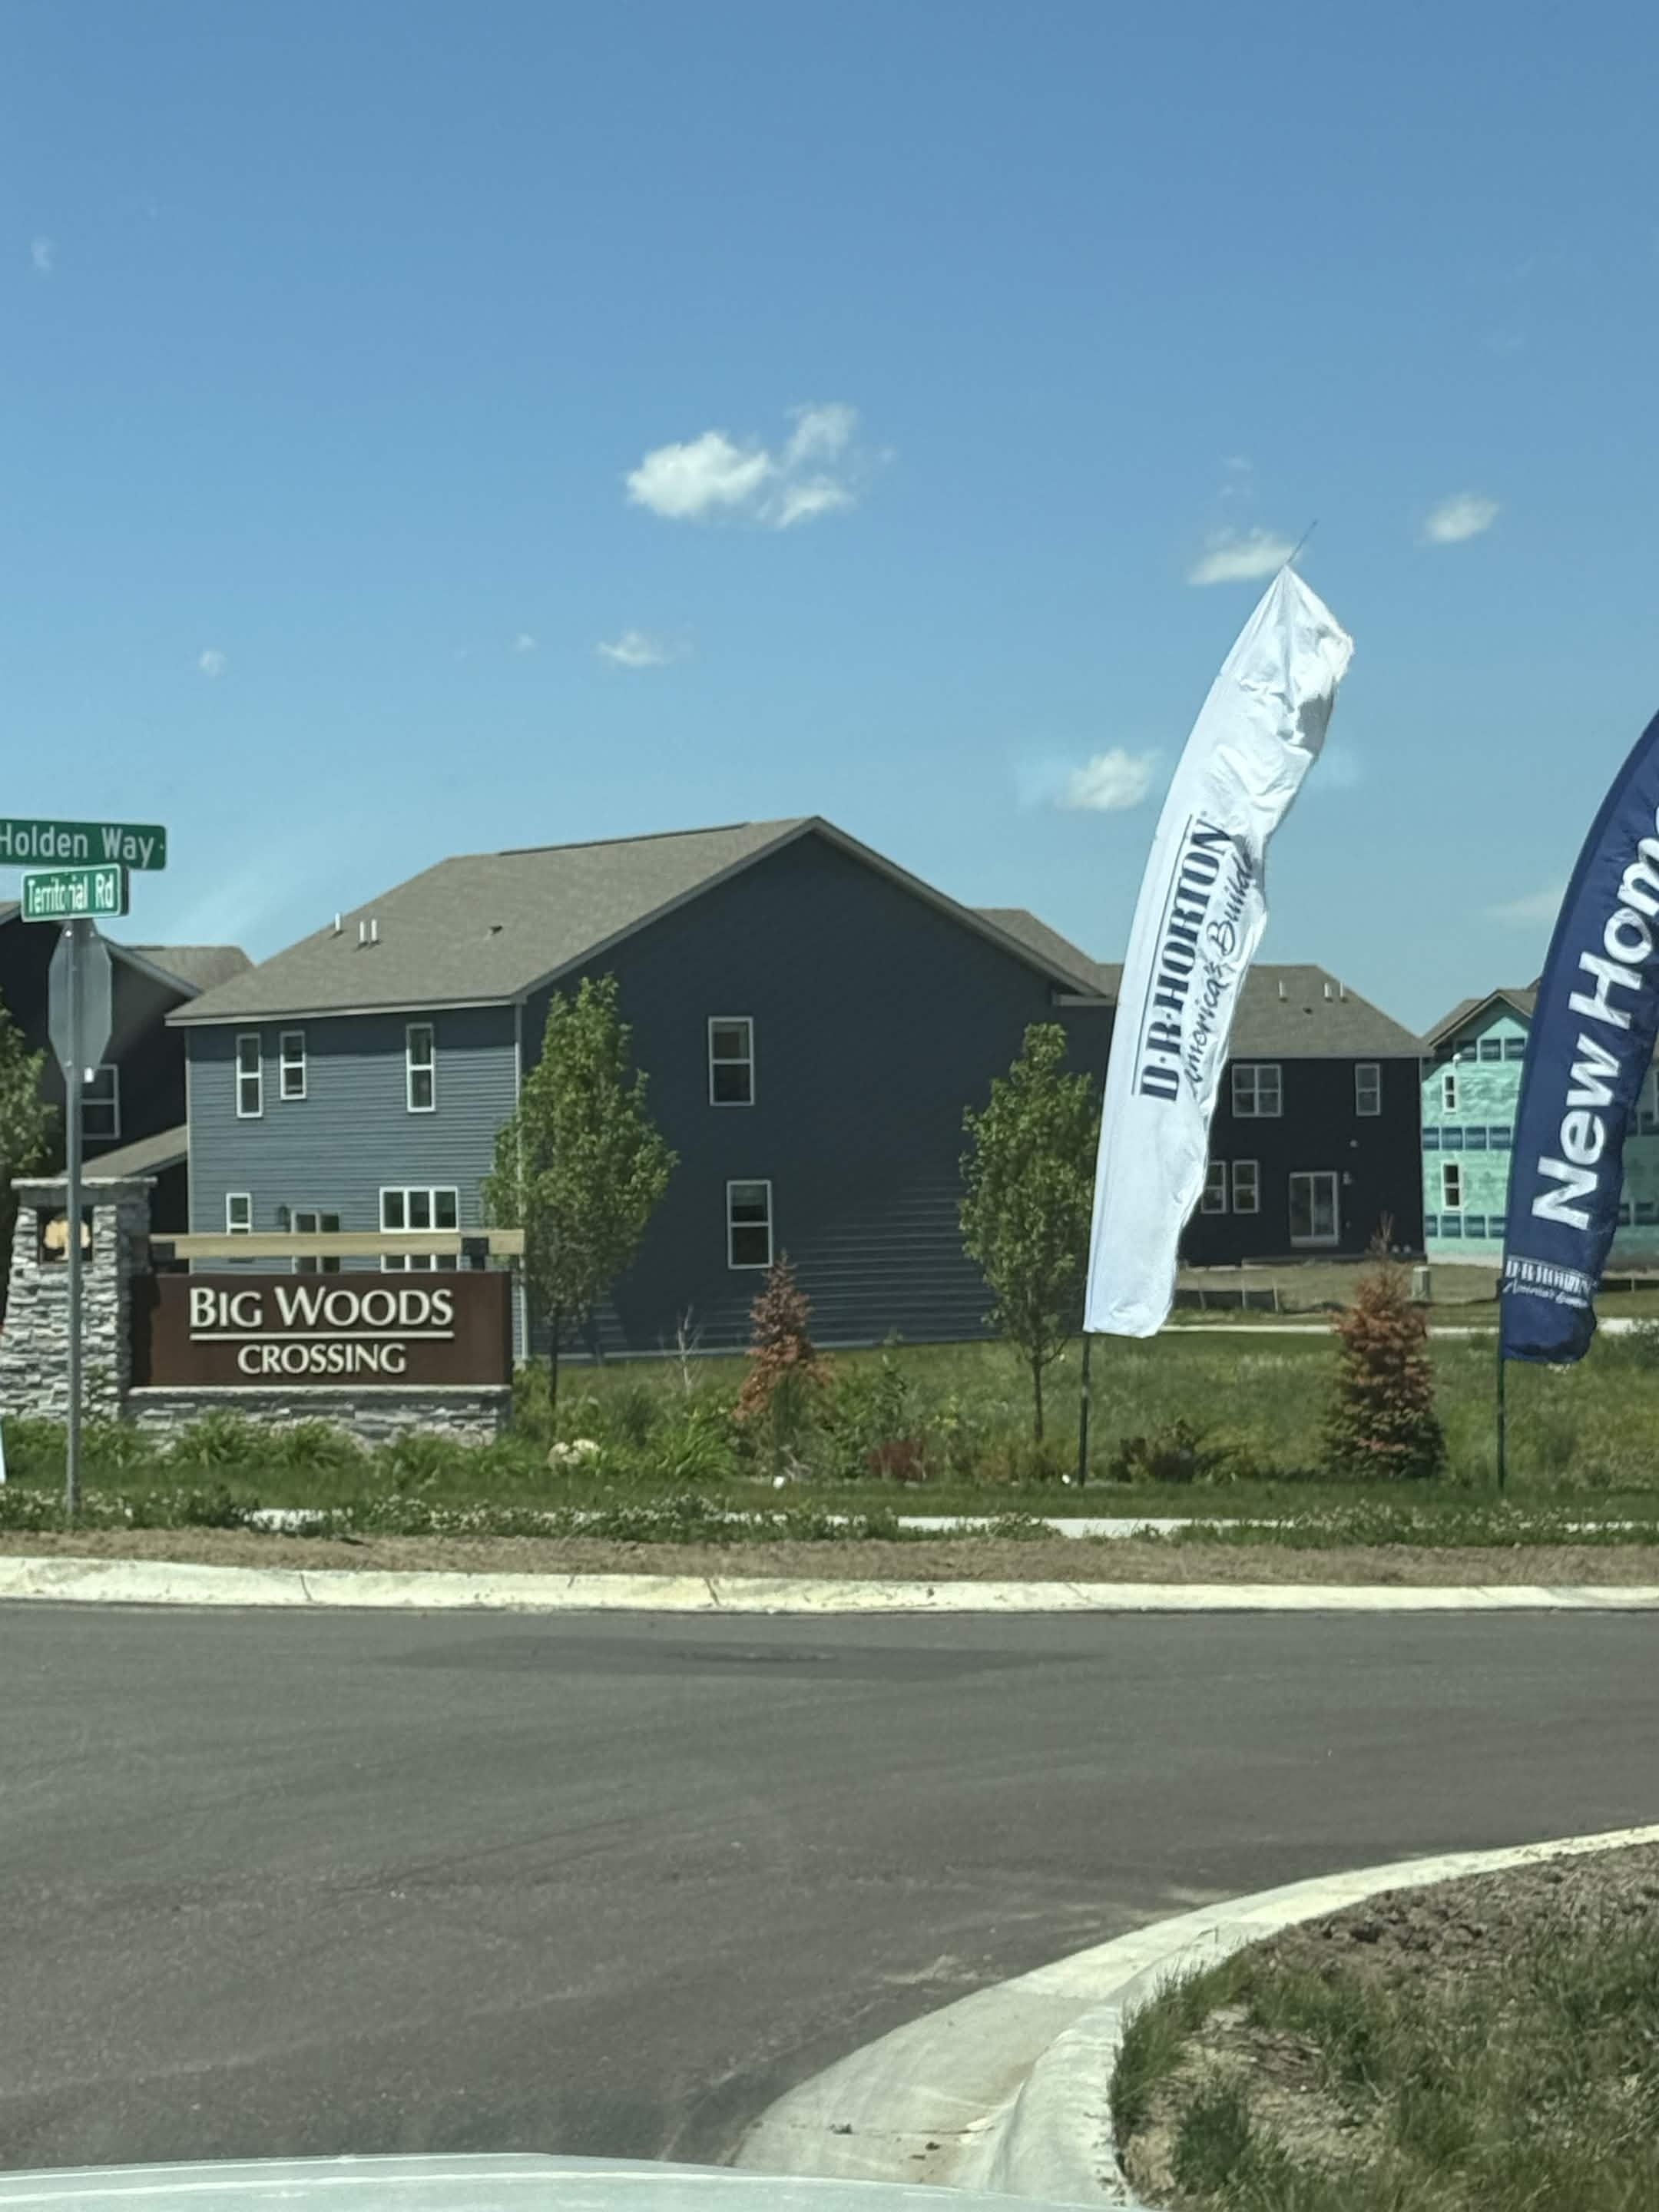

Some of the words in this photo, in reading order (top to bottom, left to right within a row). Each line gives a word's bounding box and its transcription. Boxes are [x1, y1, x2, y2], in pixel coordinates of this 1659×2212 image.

[0, 823, 88, 859] Holden
[101, 826, 154, 869] Way
[94, 873, 114, 909] Rd
[1568, 806, 1659, 1030] Hom
[1531, 1031, 1622, 1230] New
[273, 1285, 453, 1327] WOODS
[237, 1343, 406, 1374] CROSSING
